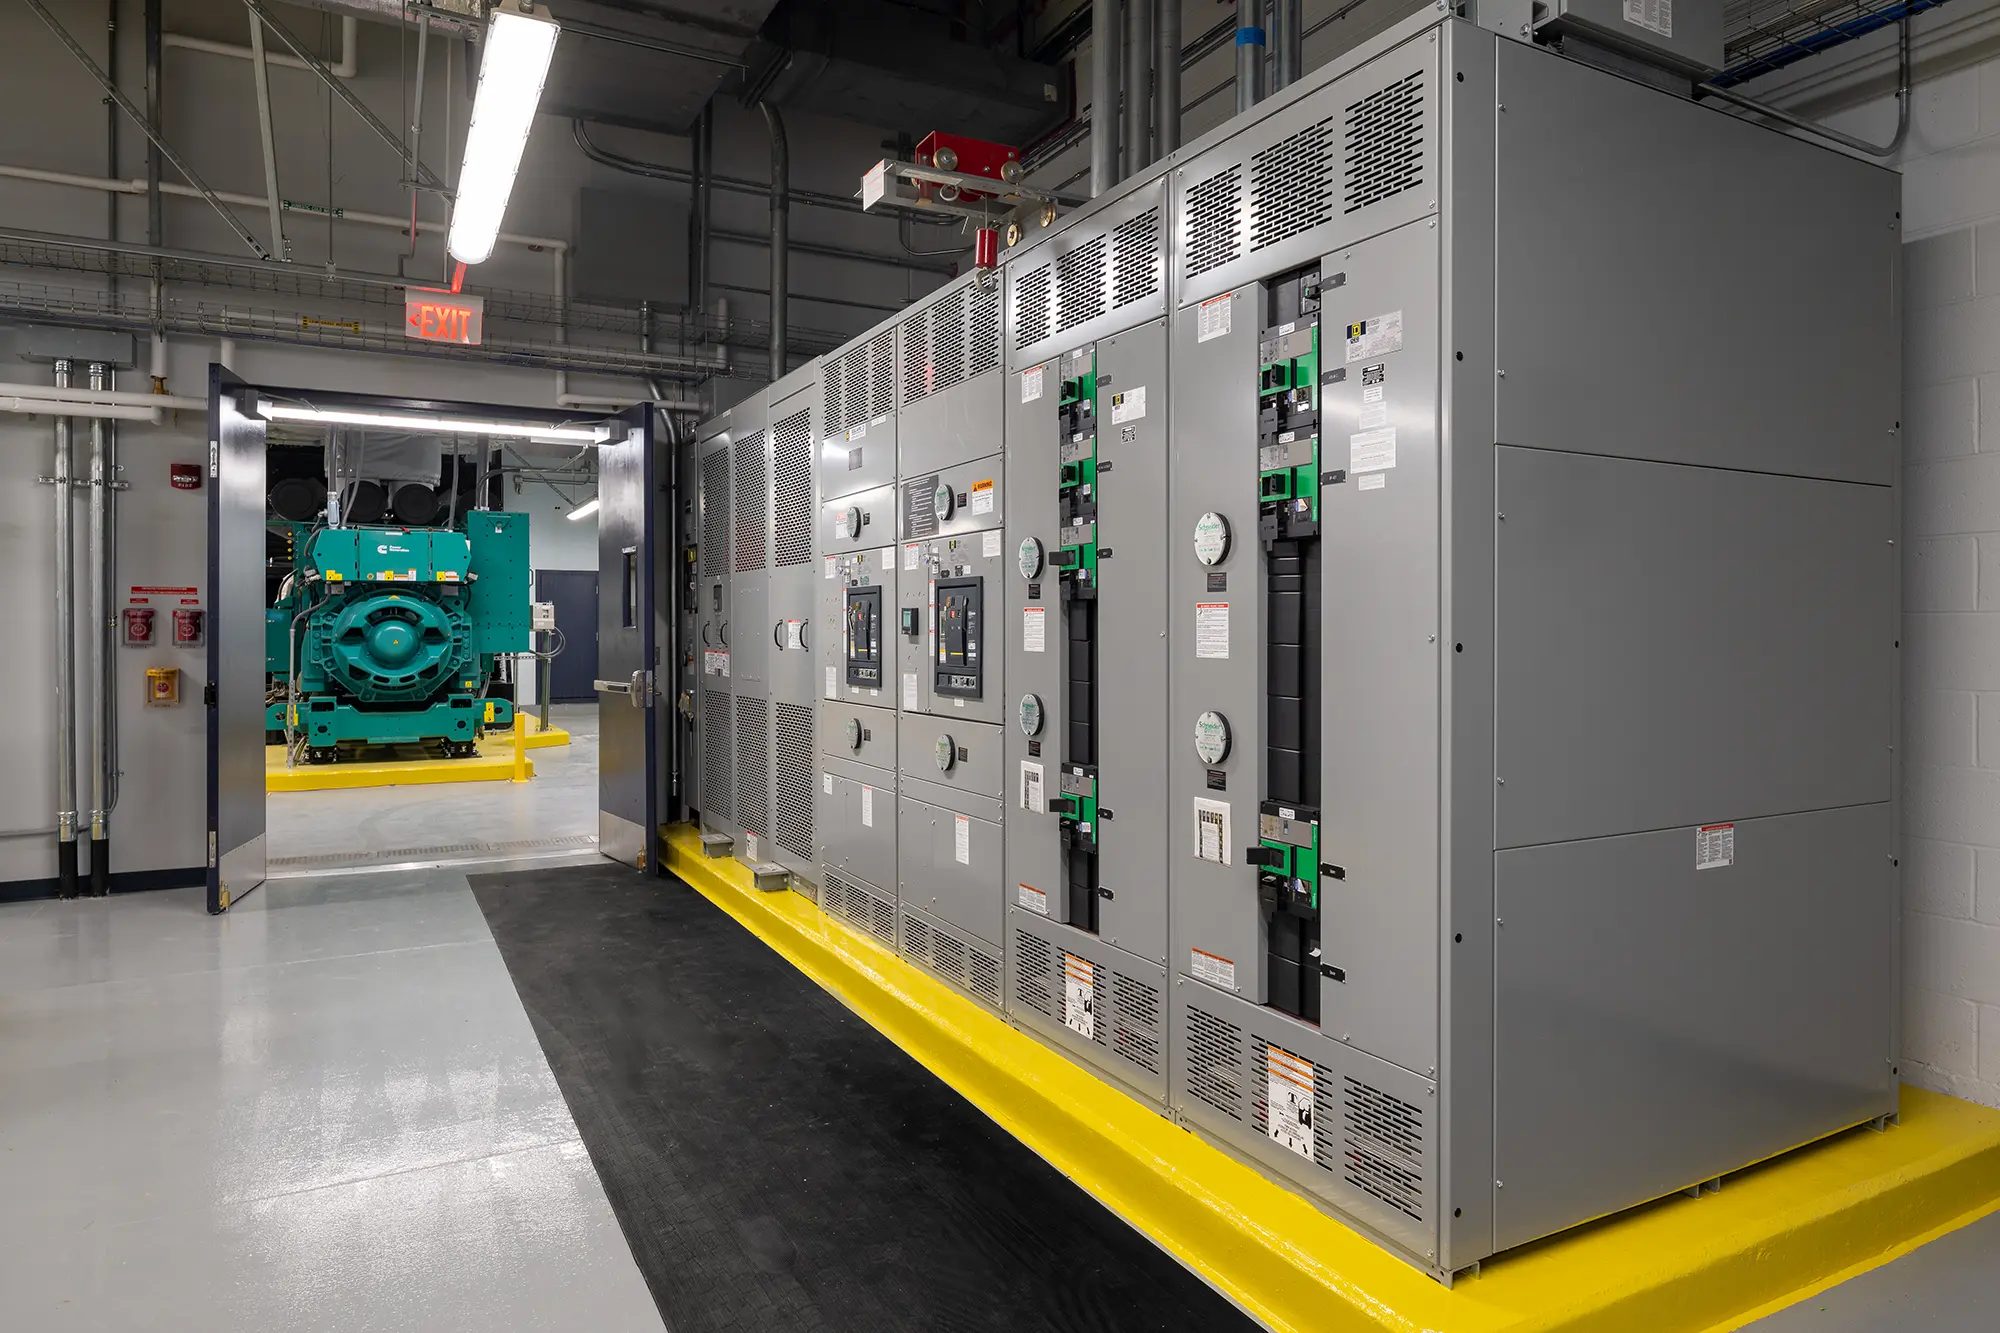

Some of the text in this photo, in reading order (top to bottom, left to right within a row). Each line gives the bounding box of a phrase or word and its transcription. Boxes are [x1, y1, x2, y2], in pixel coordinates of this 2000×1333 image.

[421, 305, 472, 341] EXIT
[977, 481, 992, 489] WARNING
[1199, 523, 1221, 531] Schneider
[1199, 721, 1221, 729] Schneider
